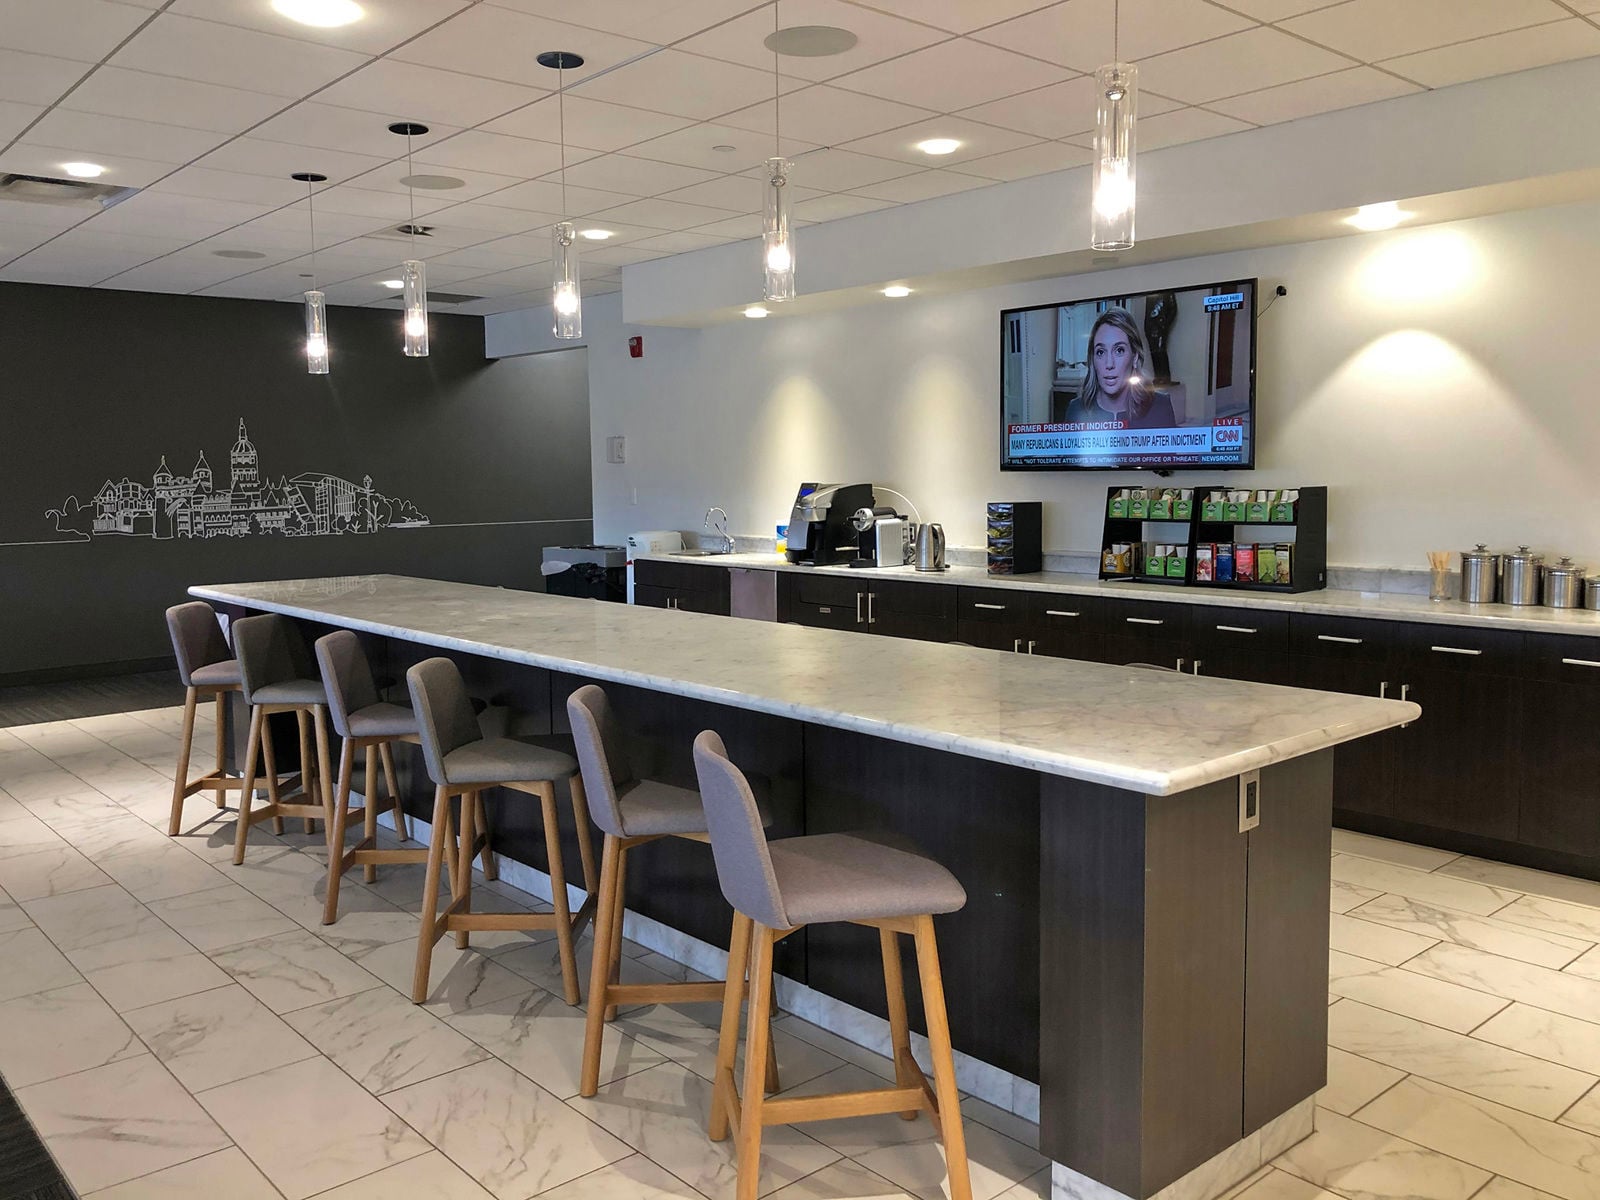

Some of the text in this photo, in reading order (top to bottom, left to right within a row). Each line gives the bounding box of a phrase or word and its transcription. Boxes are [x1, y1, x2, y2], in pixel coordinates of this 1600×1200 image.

[1208, 296, 1228, 304] Capitol
[1216, 418, 1239, 426] LIVE
[1011, 421, 1124, 433] FORMER PRESIDENT INDICTED
[1215, 429, 1239, 442] CNN
[1011, 433, 1206, 450] MANY REPUBLICANS & LOYALISTS RALLY BEHIND TRUMP AFTER INDICTMENT
[1162, 455, 1172, 463] OR
[1201, 454, 1239, 462] NEWSROOM
